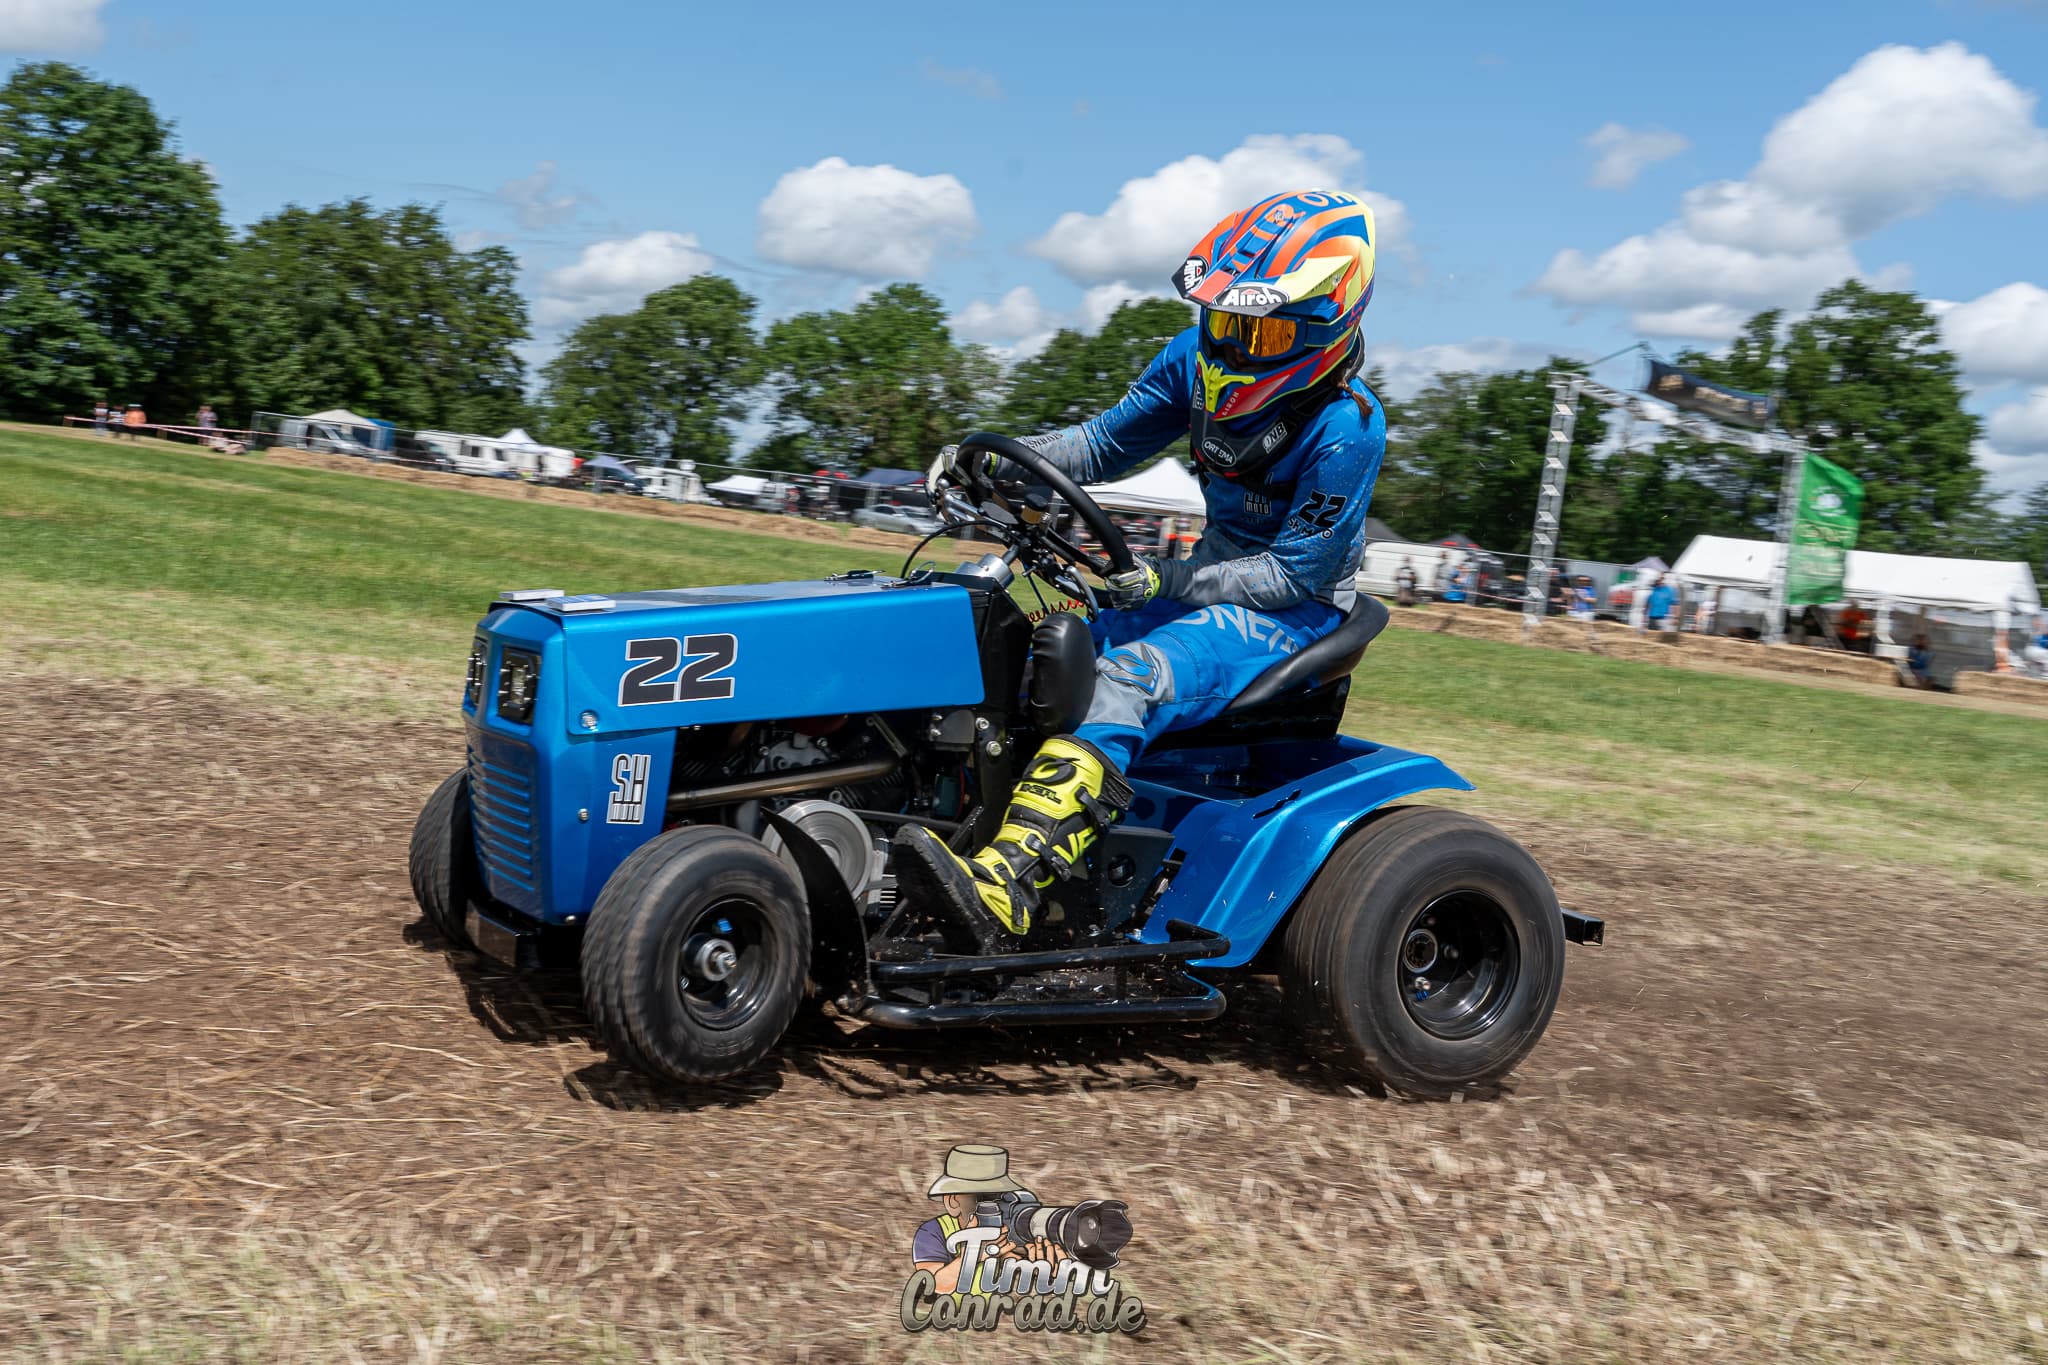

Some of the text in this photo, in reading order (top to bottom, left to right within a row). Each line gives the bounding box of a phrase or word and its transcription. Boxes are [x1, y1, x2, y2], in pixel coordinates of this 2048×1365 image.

[1222, 287, 1282, 306] Airoh
[1298, 488, 1347, 528] 22
[618, 633, 738, 707] 22
[610, 754, 651, 805] SH
